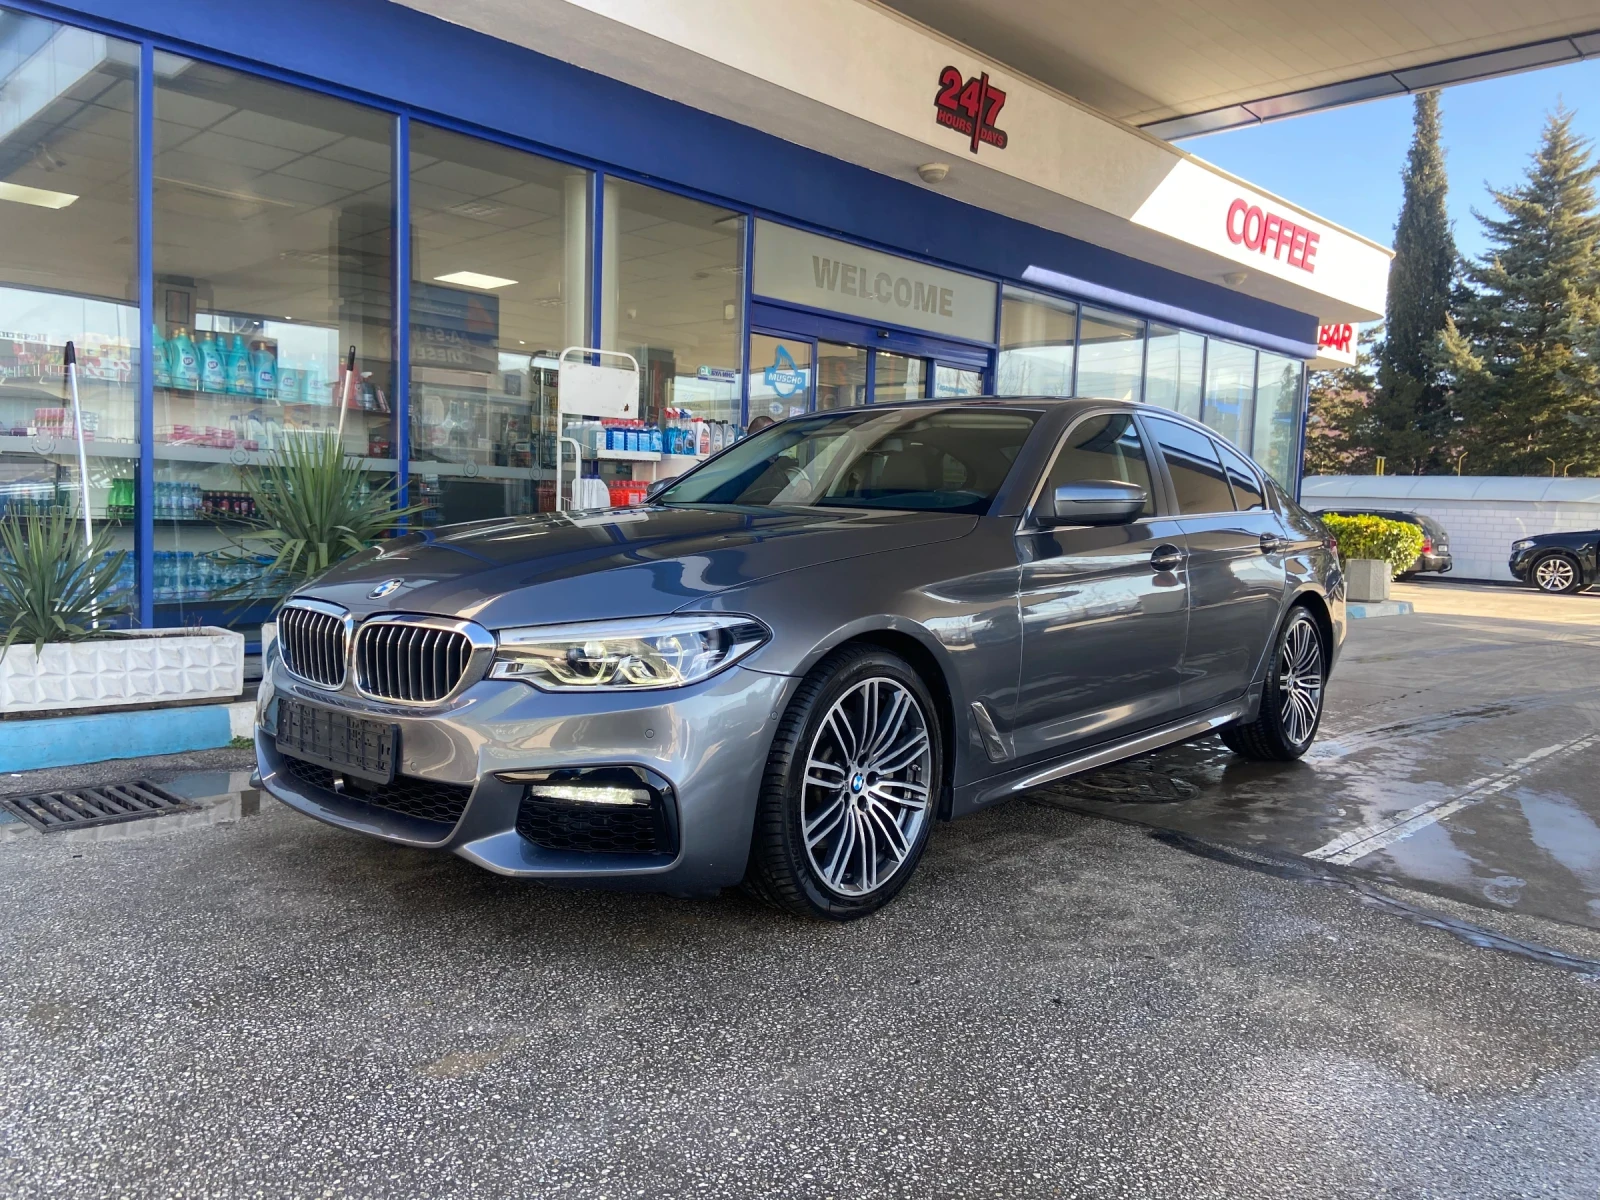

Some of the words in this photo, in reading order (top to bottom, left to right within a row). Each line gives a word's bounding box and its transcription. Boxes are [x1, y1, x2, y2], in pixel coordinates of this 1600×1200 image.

[938, 109, 972, 134] HOURS
[980, 128, 1004, 147] DAYS
[1226, 197, 1321, 274] COFFEE
[812, 255, 954, 318] WELCOME
[1318, 322, 1353, 353] BAR
